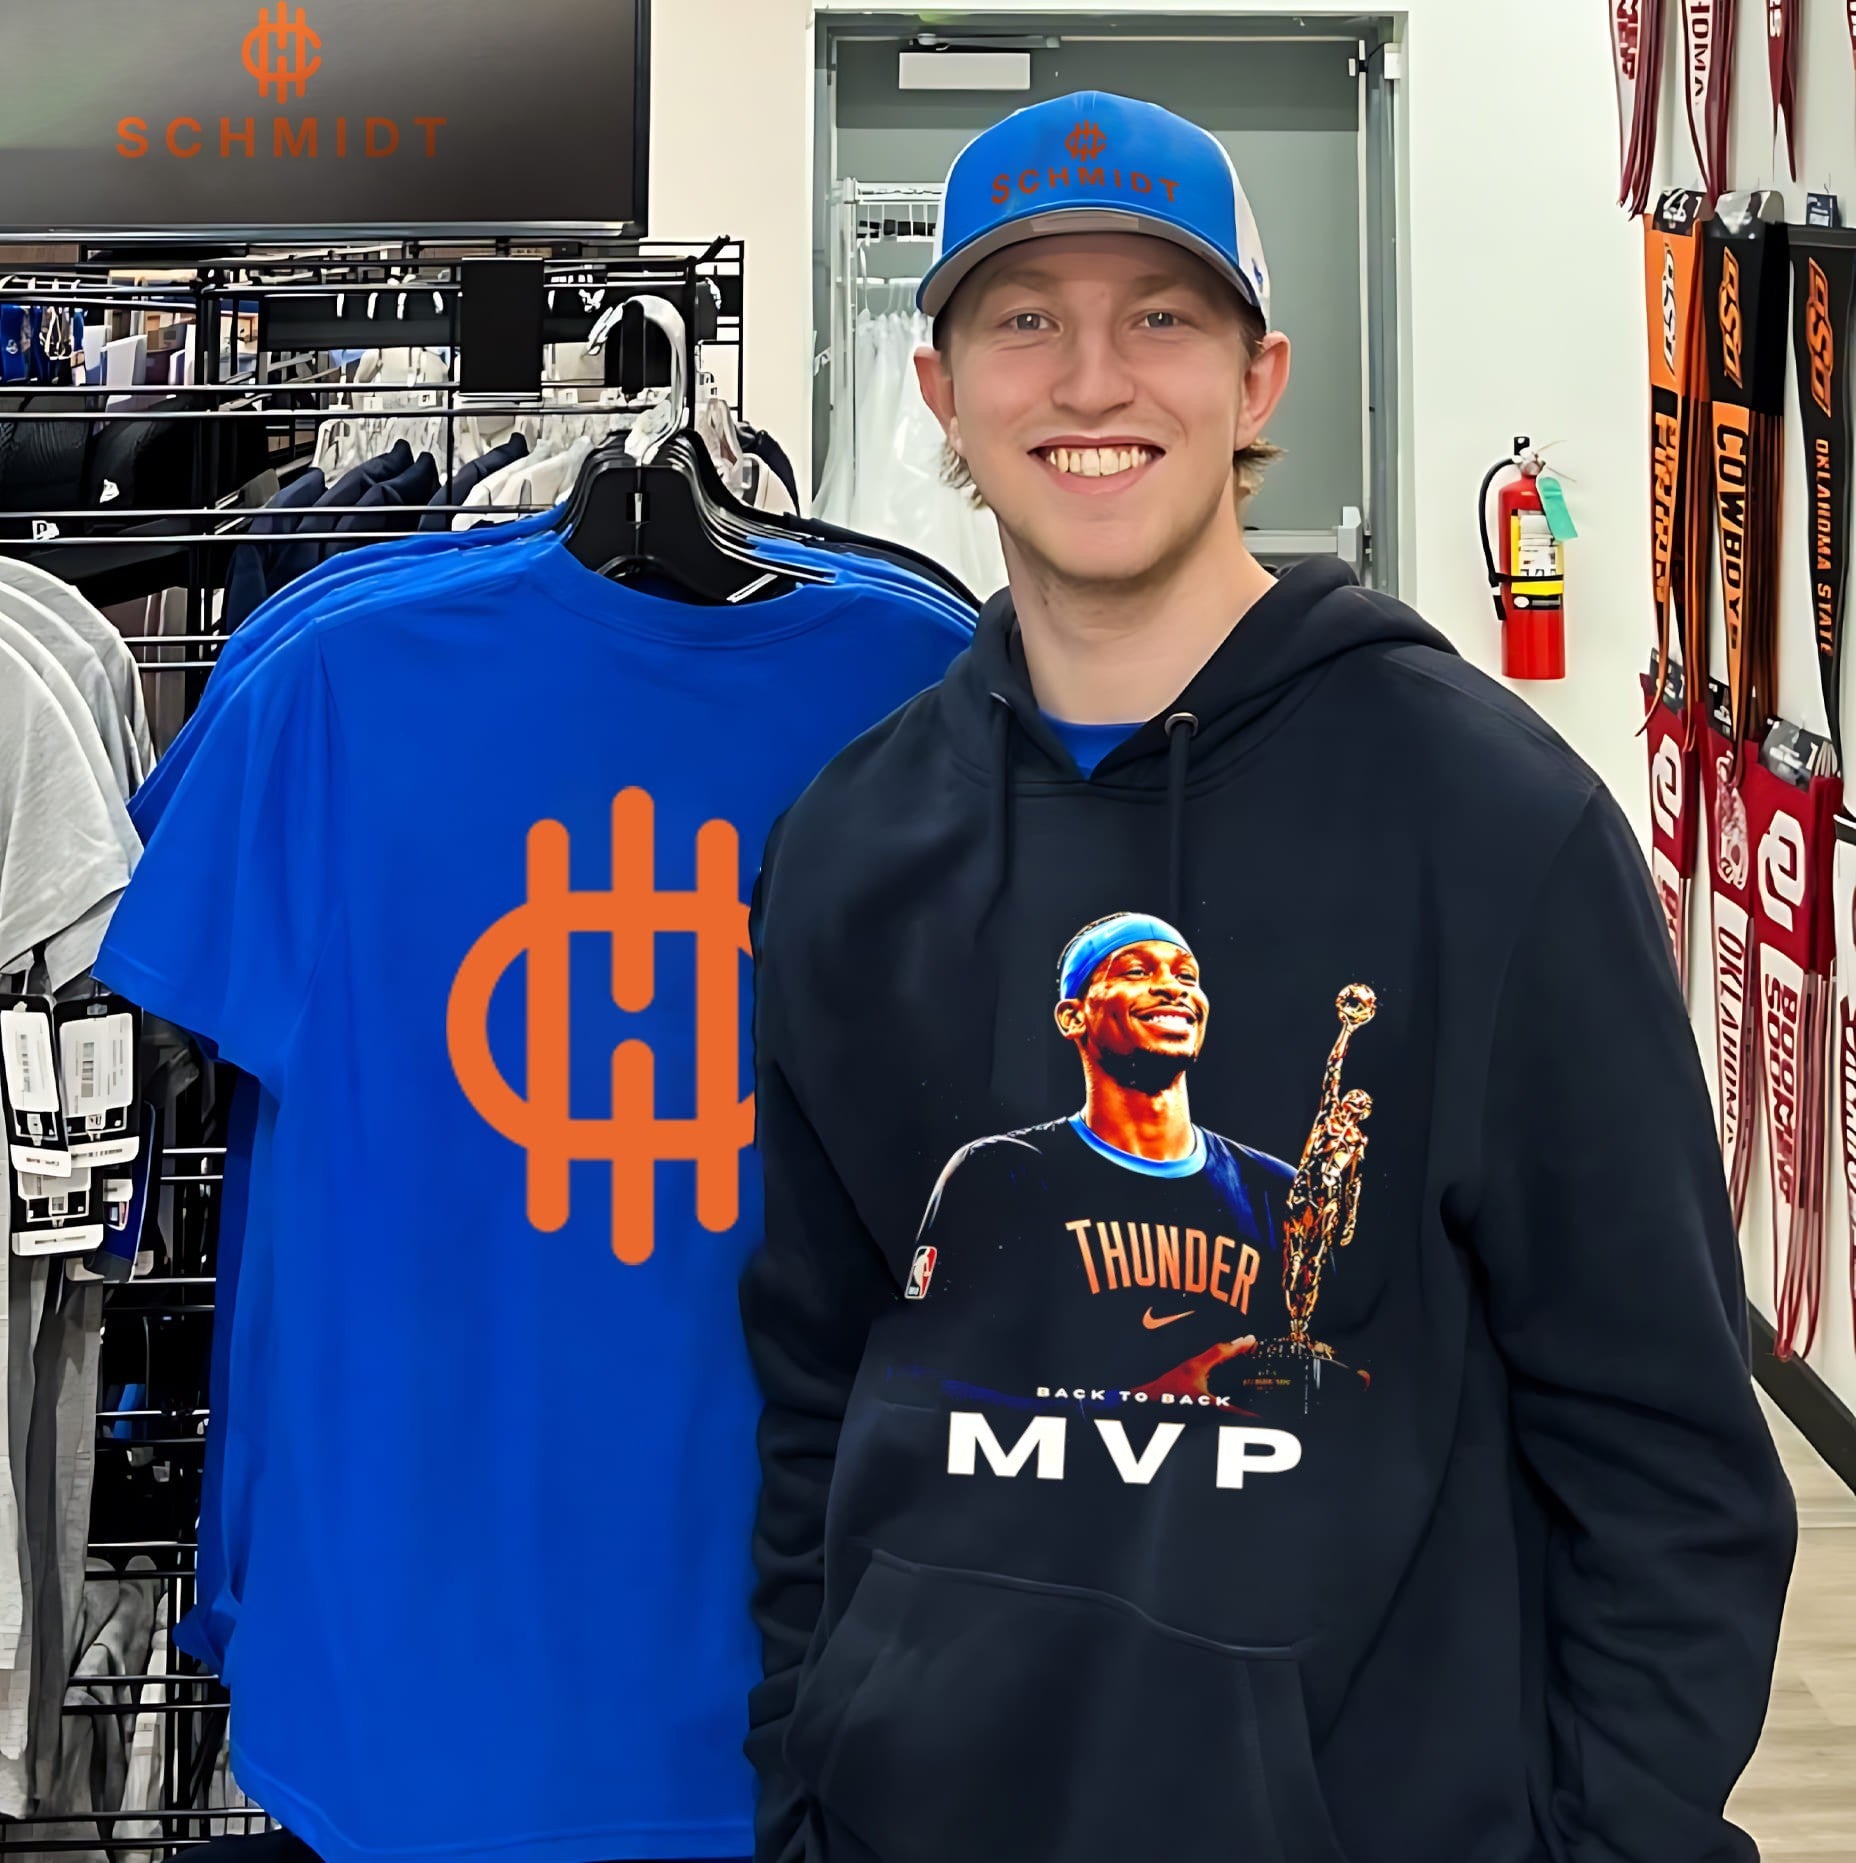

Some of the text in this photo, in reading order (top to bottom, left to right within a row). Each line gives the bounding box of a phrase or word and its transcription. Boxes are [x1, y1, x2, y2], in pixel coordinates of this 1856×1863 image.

[115, 116, 447, 158] SCHMIDT
[991, 167, 1179, 204] SCHMIDT
[1815, 438, 1832, 571] OKLAHOMA
[1718, 925, 1746, 1144] OKLAHOMA
[1065, 1219, 1260, 1315] THUNDER
[1036, 1386, 1231, 1407] BACK TO BACK
[946, 1411, 1302, 1489] MVP
